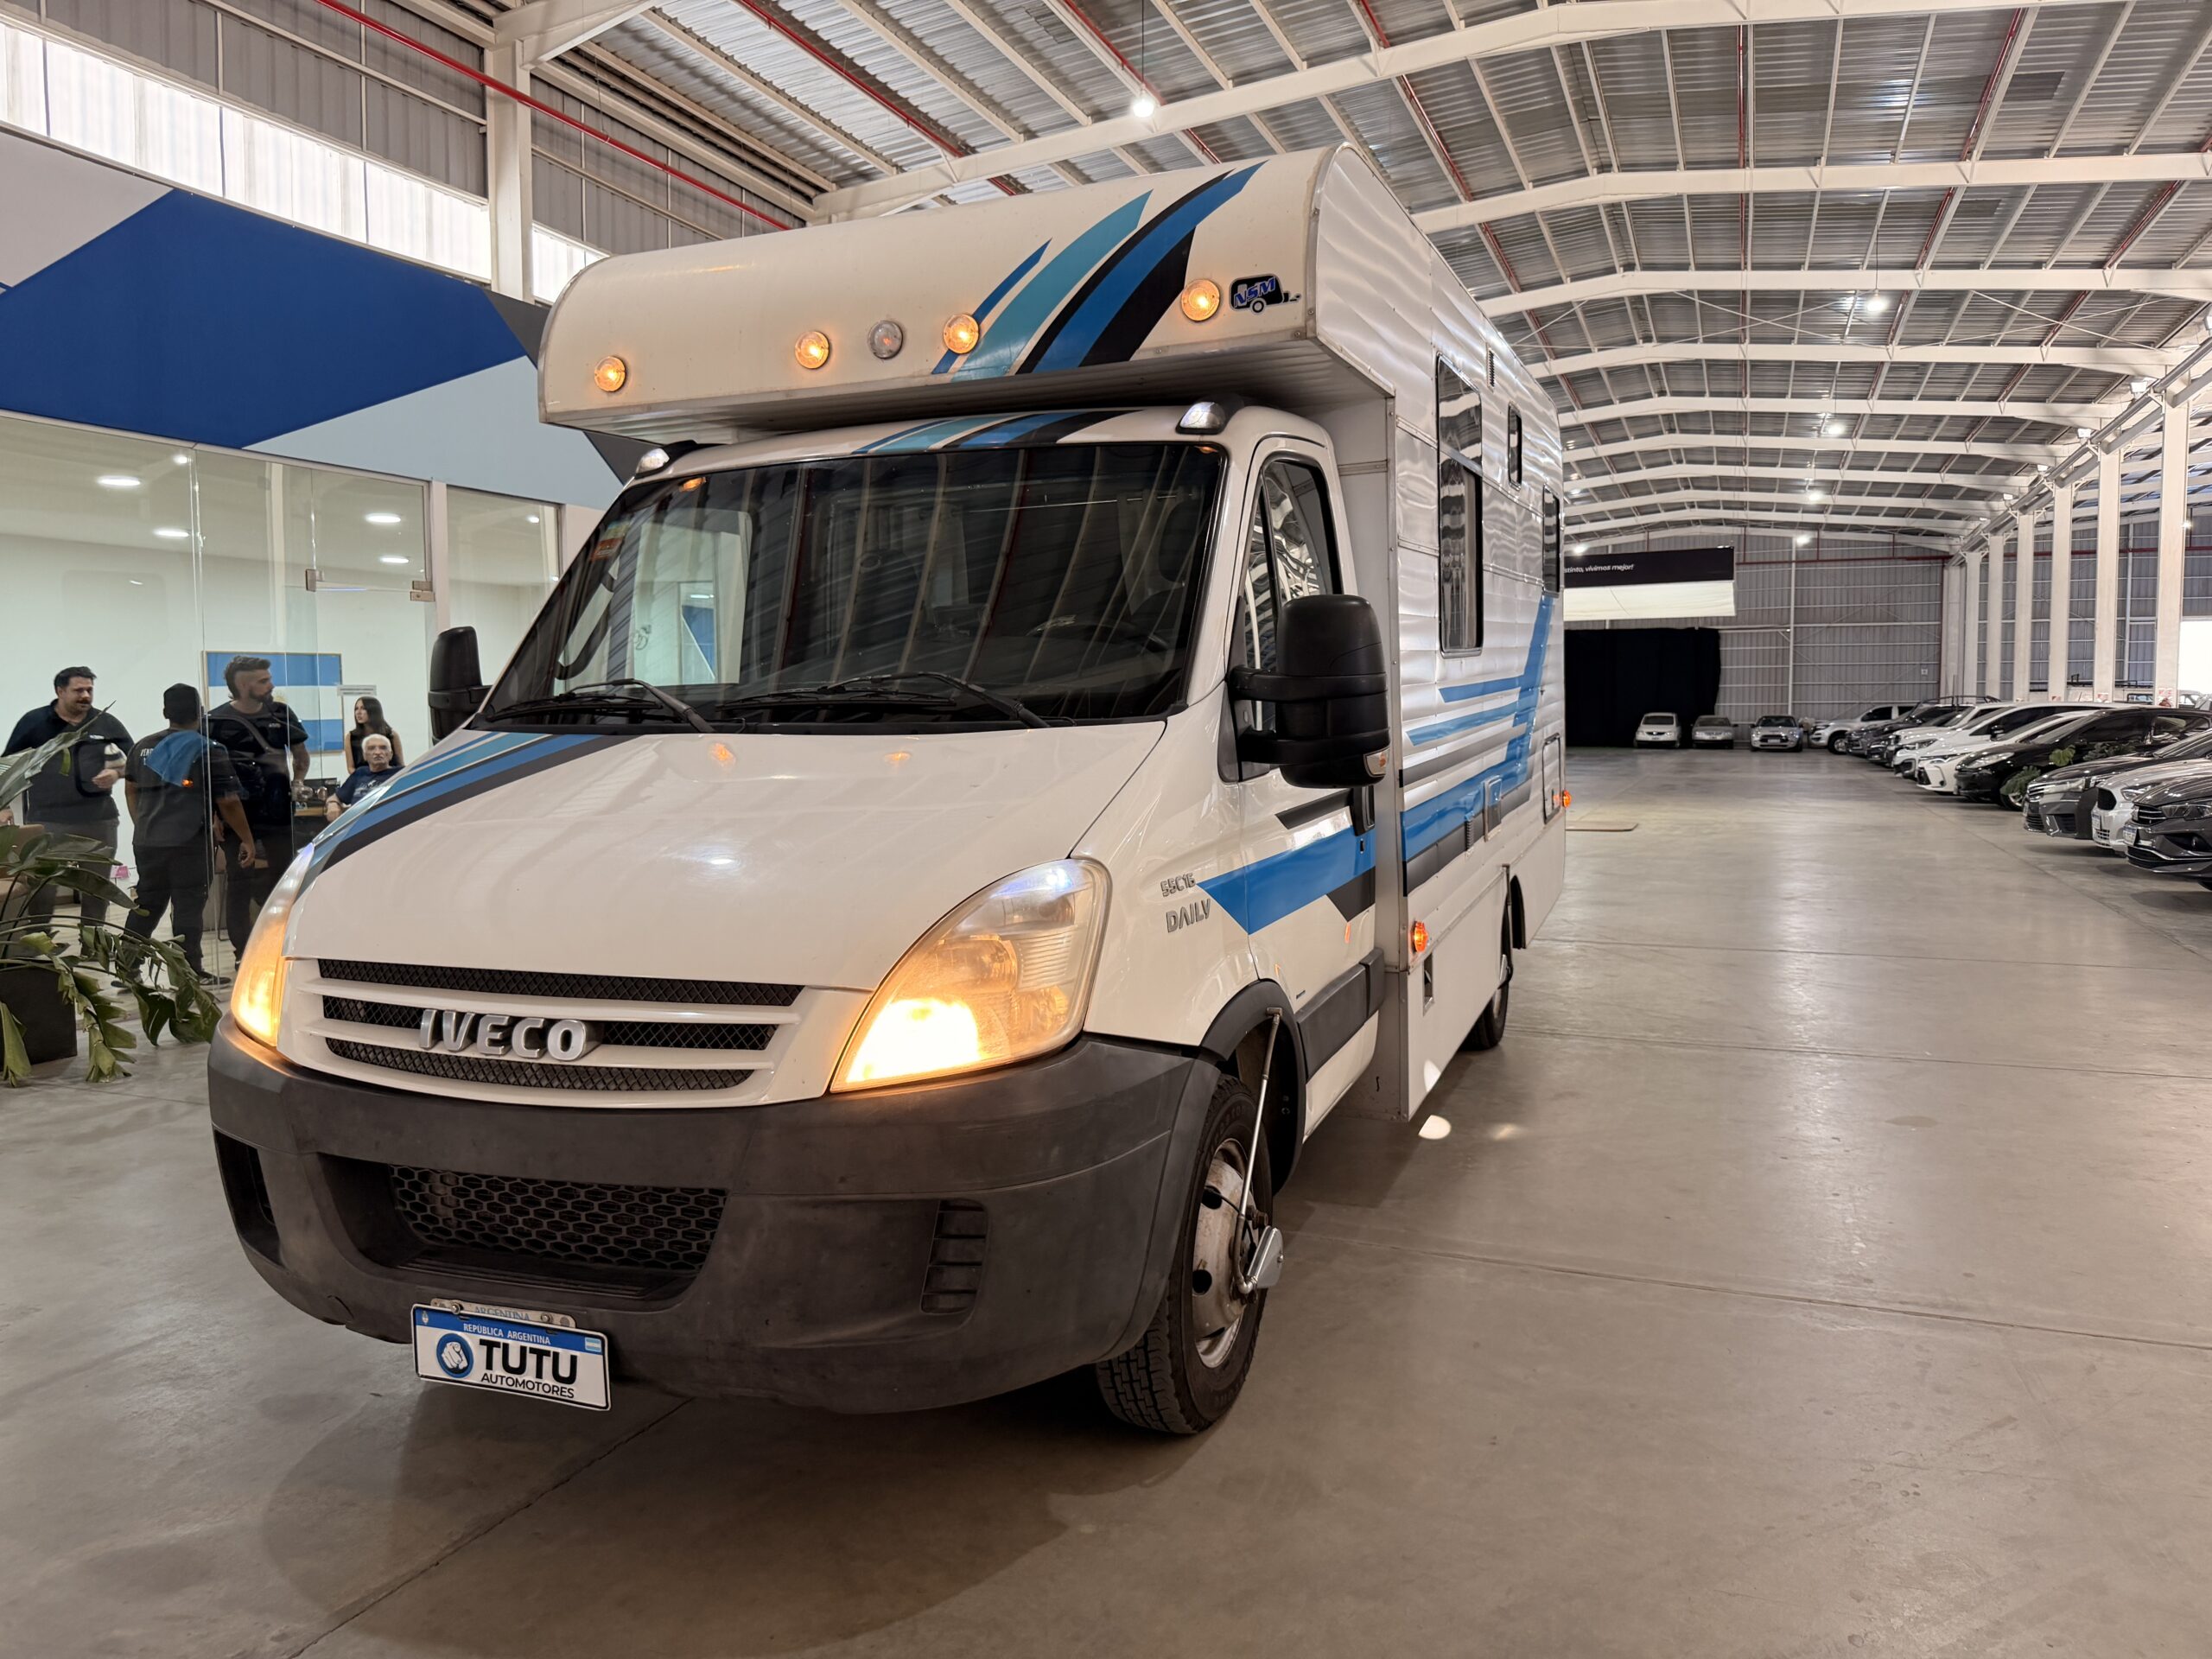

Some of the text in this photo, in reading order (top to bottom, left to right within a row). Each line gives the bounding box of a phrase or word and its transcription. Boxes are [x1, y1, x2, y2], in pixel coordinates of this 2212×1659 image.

[1611, 563, 1634, 572] mejor!
[1166, 898, 1211, 933] DAILY
[418, 1007, 588, 1062] IVECO
[463, 1323, 551, 1345] REPÚBLICA ARGENTINA
[479, 1338, 578, 1385] TUTU
[480, 1372, 575, 1399] AUTOMOTORES
